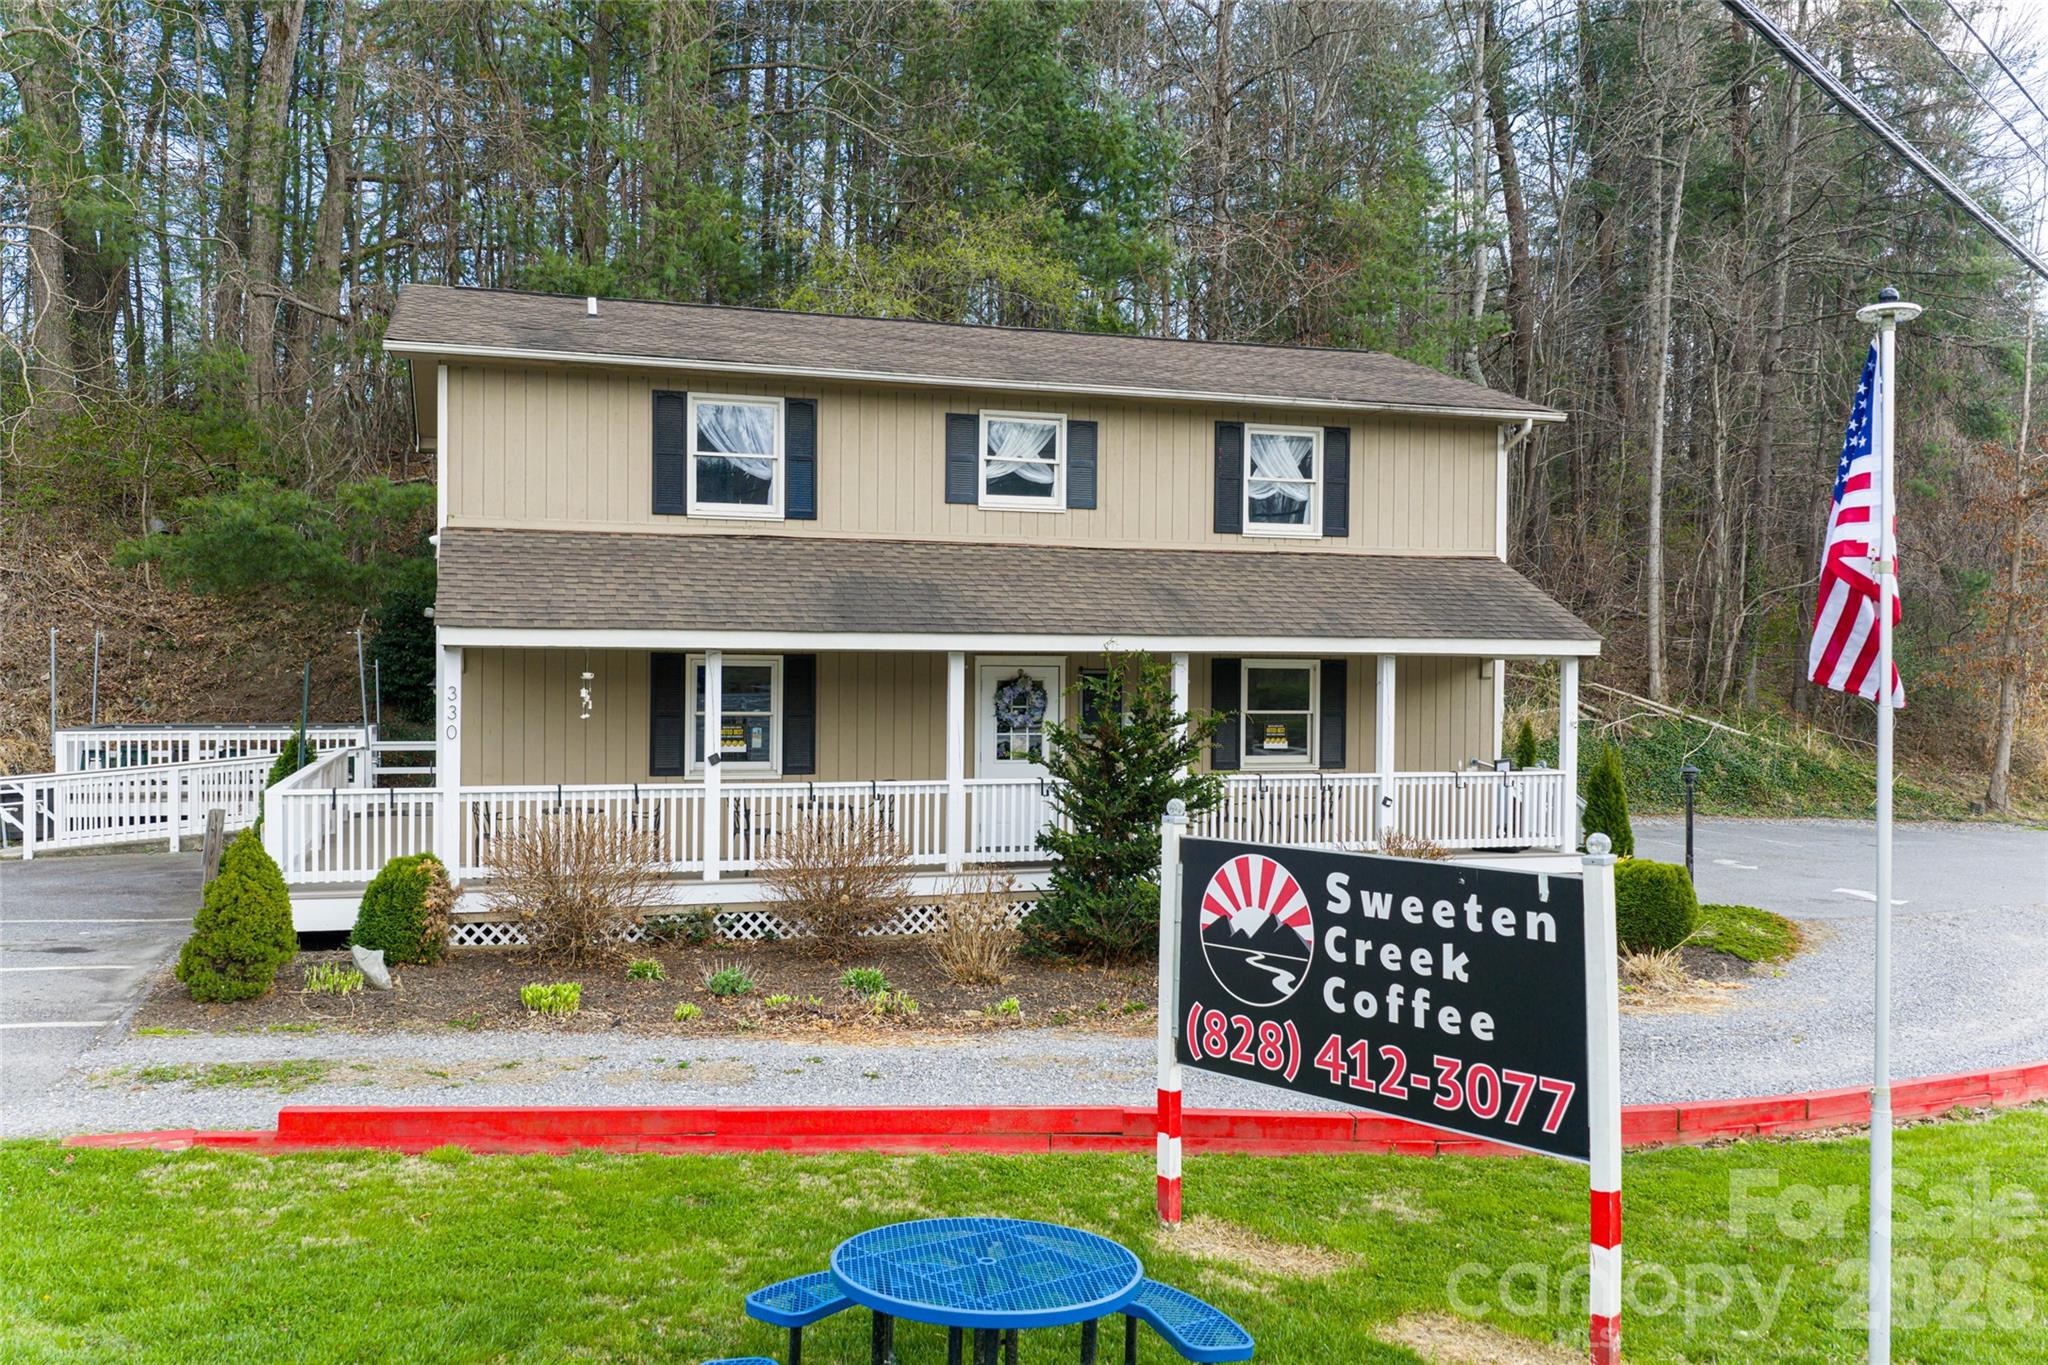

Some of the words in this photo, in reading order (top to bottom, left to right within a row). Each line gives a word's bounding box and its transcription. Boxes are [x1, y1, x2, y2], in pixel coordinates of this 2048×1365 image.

[446, 685, 458, 740] 330
[1326, 872, 1557, 943] Sweeten
[1324, 926, 1470, 983] Creek
[1323, 976, 1495, 1041] Coffee
[1187, 1001, 1302, 1083] (828)
[1314, 1034, 1576, 1135] 412-3077
